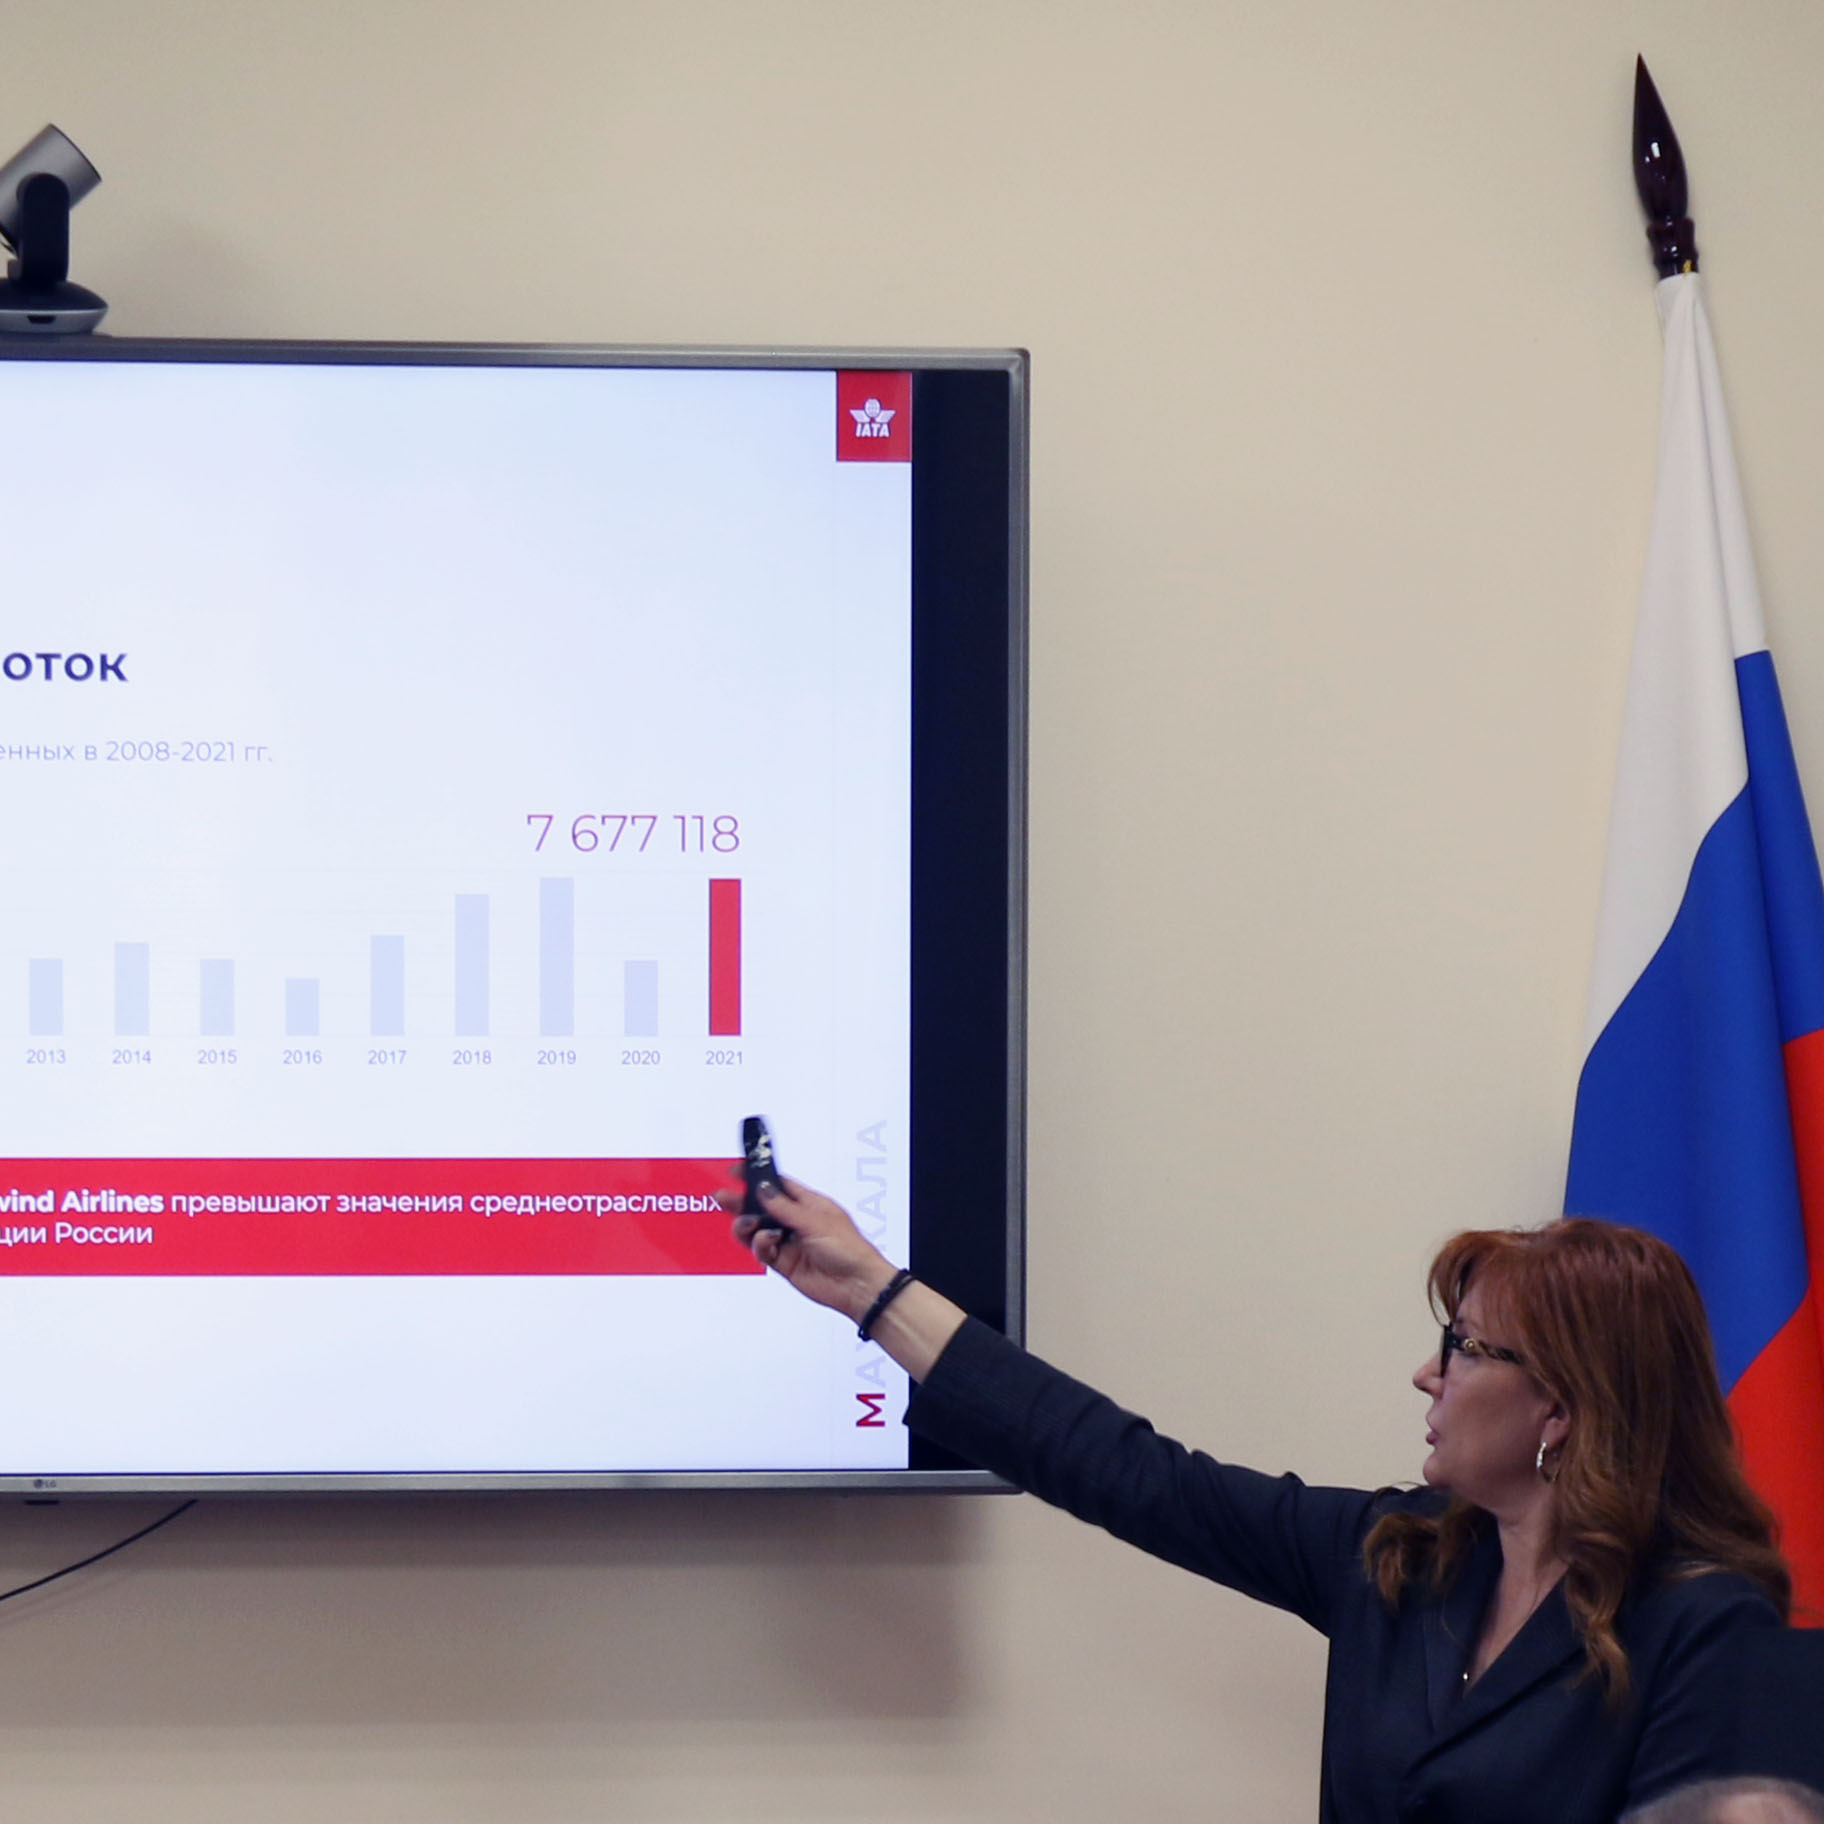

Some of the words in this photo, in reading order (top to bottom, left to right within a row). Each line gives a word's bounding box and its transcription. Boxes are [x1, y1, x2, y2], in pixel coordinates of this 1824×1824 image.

[855, 422, 890, 438] IATA
[84, 744, 98, 761] в
[105, 740, 235, 763] 2008-2021
[244, 745, 273, 763] гг.
[526, 813, 555, 852] 7
[571, 814, 659, 853] 677
[673, 814, 740, 853] 118
[25, 1048, 67, 1065] 2013
[111, 1048, 153, 1065] 2014
[197, 1048, 238, 1065] 2015
[282, 1048, 323, 1065] 2016
[367, 1048, 408, 1065] 2017
[452, 1049, 492, 1066] 2018
[536, 1047, 577, 1066] 2019
[621, 1049, 662, 1066] 2020
[705, 1049, 744, 1066] 2021
[61, 1188, 165, 1214] Airlines
[171, 1194, 331, 1218] превышают
[336, 1194, 463, 1213] значения
[470, 1194, 723, 1218] среднеотраслевых
[54, 1222, 154, 1245] России
